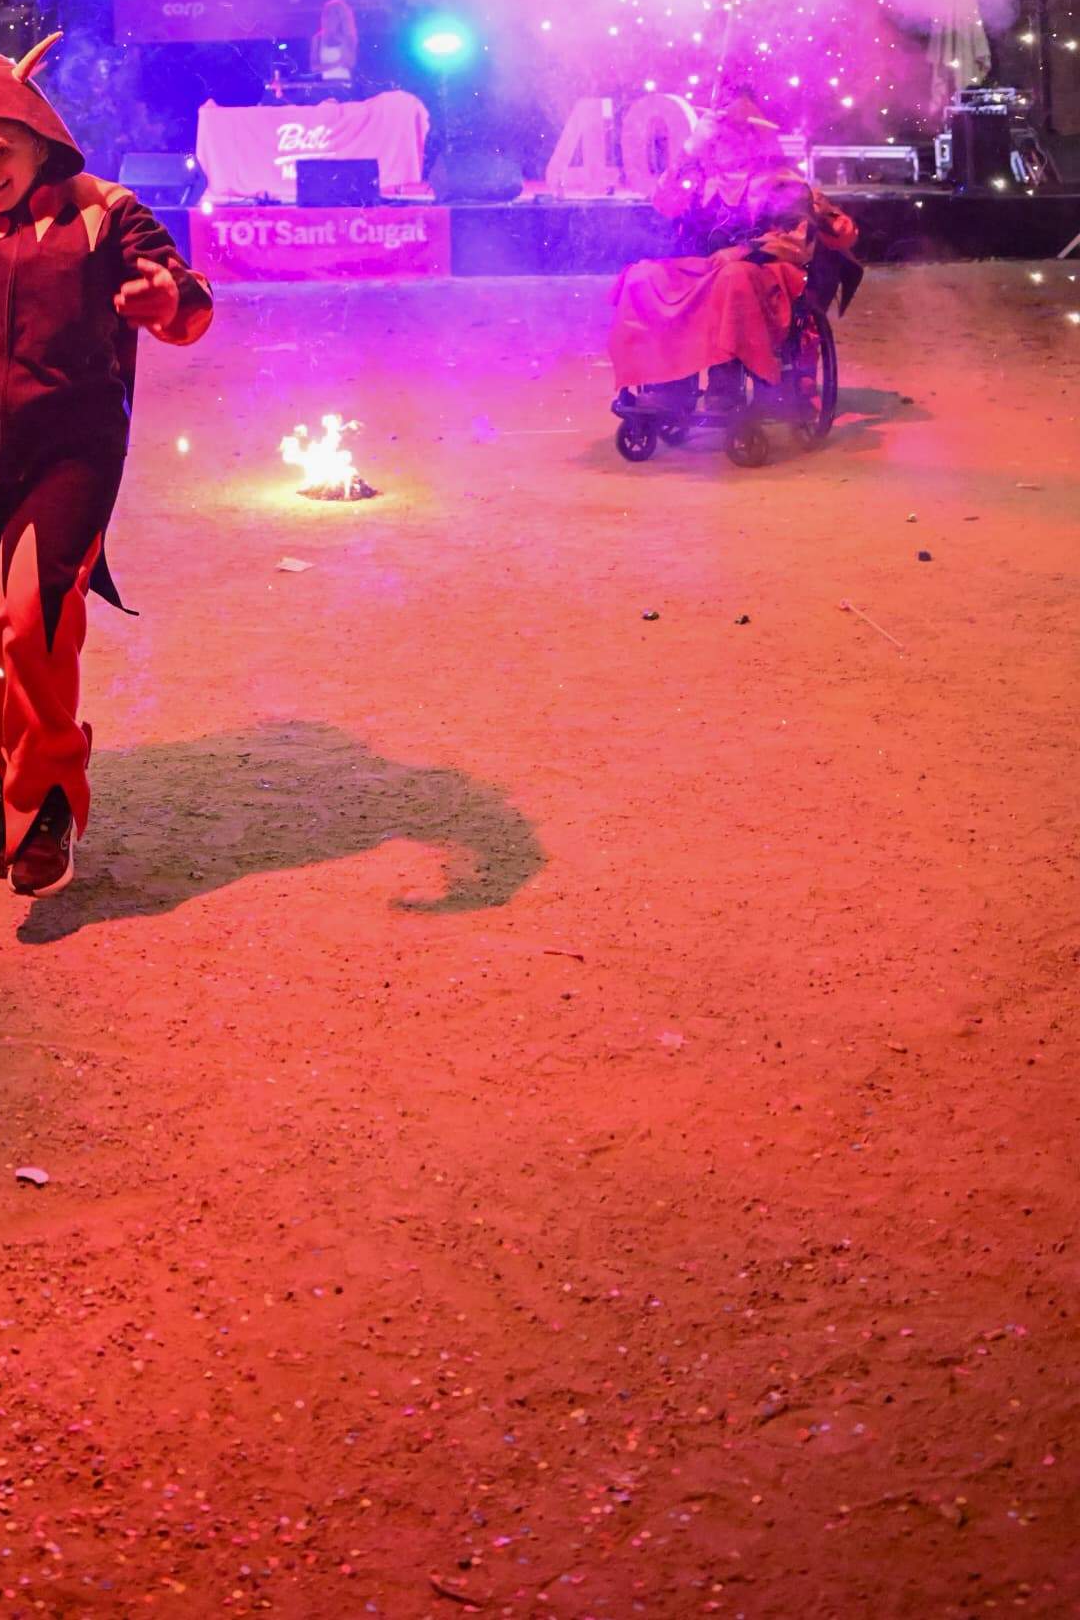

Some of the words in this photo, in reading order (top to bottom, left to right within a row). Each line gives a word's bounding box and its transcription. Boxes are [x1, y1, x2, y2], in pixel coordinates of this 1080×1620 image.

[545, 93, 697, 201] 40
[212, 221, 272, 246] TOT
[275, 220, 336, 245] Sant
[349, 218, 427, 249] Cugat
